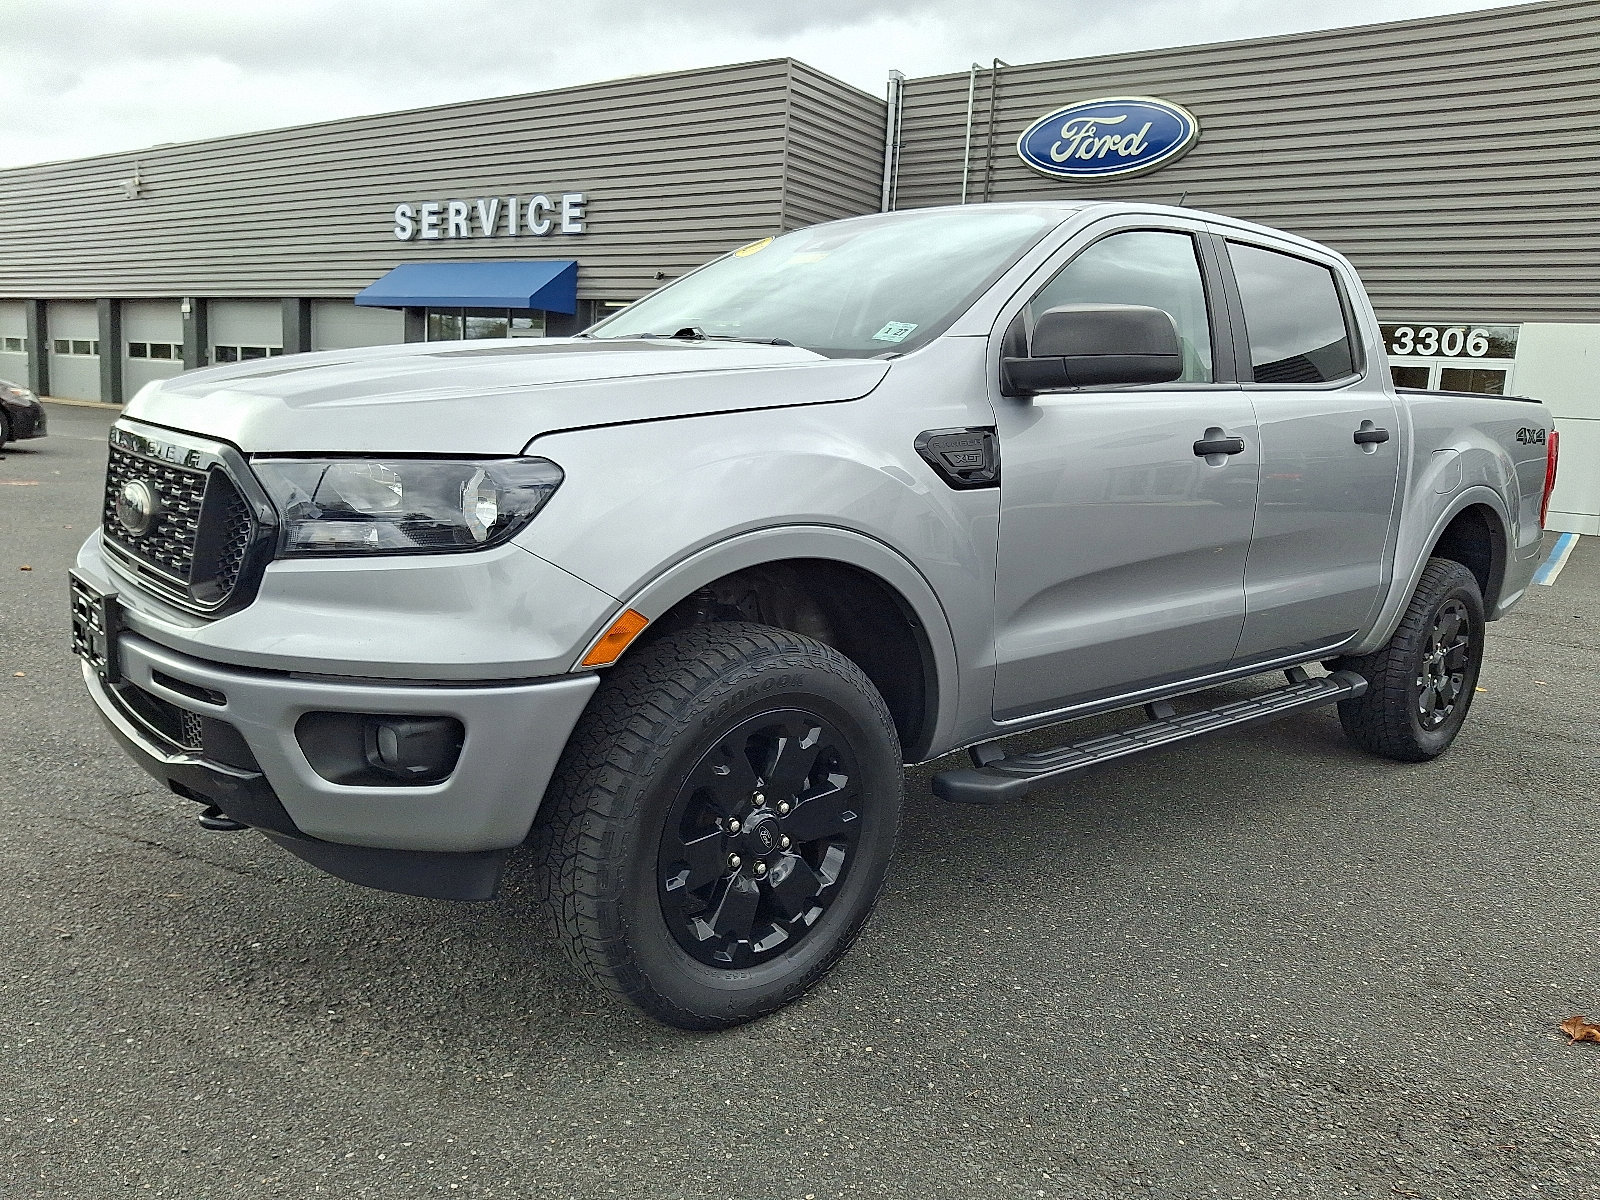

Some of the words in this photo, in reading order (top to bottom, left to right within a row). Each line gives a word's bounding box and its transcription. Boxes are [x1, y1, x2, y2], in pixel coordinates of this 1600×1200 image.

[1050, 114, 1153, 163] Ford
[394, 193, 585, 241] SERVICE
[1392, 326, 1490, 357] 3306
